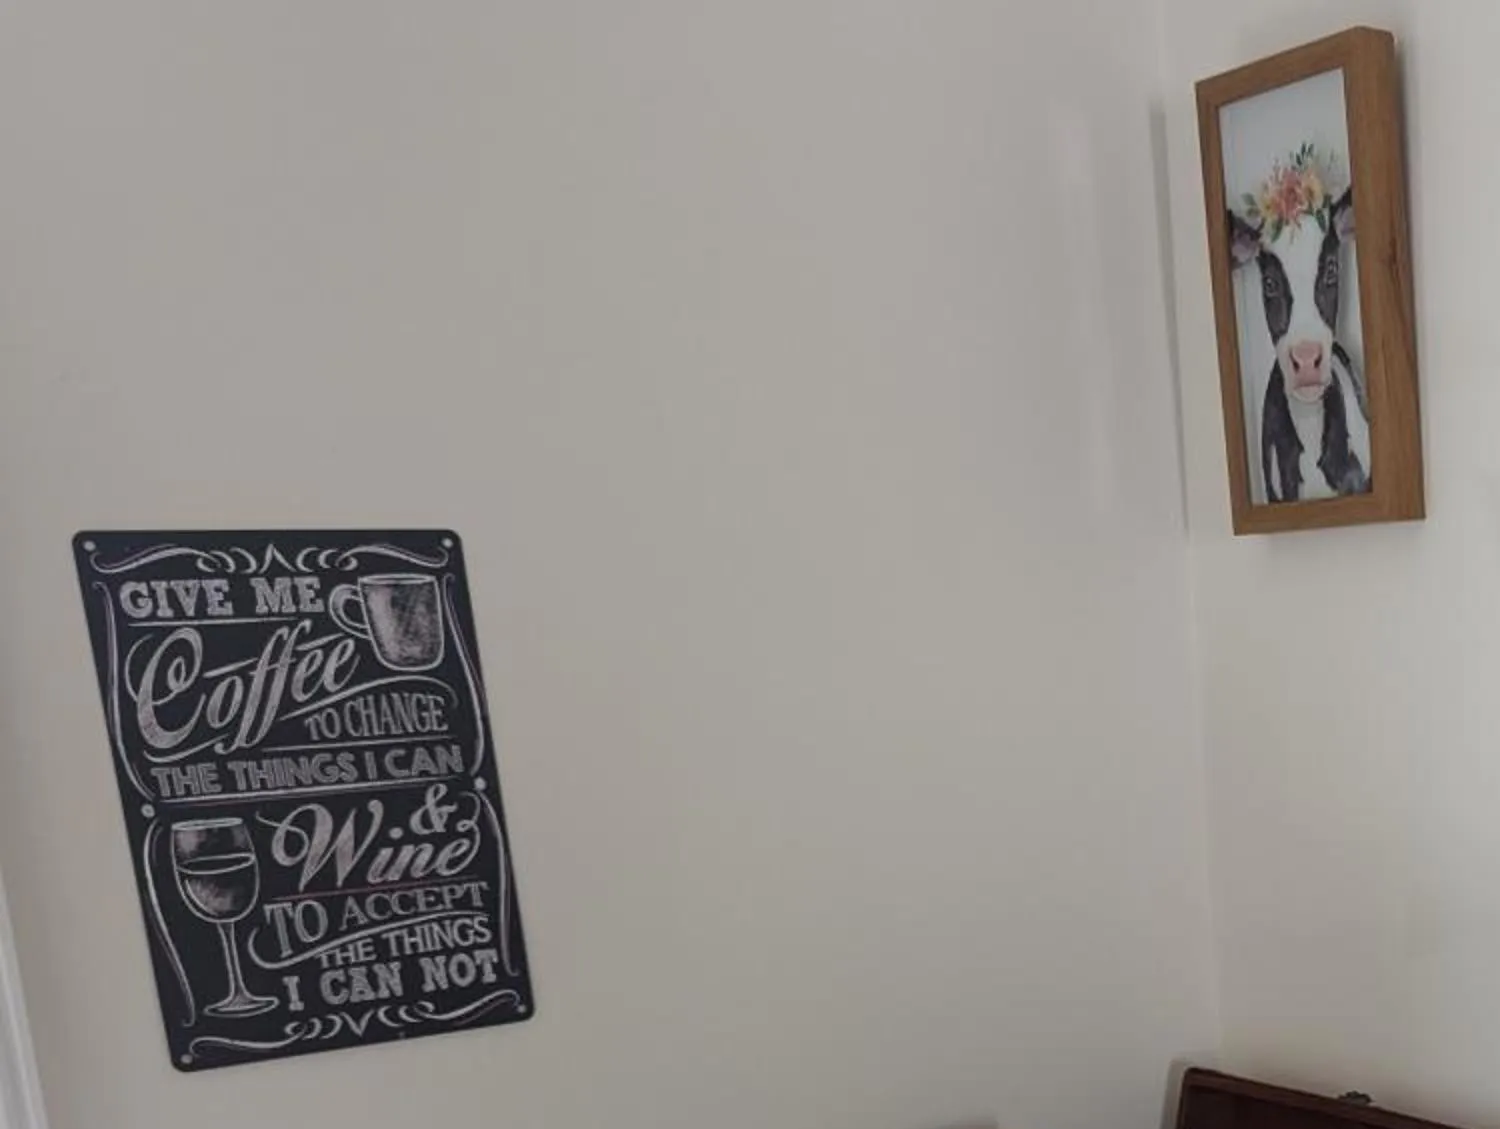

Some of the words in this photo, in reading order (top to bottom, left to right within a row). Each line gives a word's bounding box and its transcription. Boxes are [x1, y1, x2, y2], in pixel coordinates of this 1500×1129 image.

[119, 576, 234, 619] GIVE
[249, 576, 326, 615] ME
[125, 619, 361, 754] Coffee
[304, 713, 341, 741] TO
[343, 695, 450, 738] CHANGE
[150, 762, 223, 797] THE
[228, 751, 357, 790] THINGS
[364, 750, 375, 780] I
[384, 744, 465, 779] CAN
[410, 783, 457, 835] &
[256, 799, 481, 890] Wine
[264, 899, 329, 958] TO
[338, 881, 491, 932] ACCEPT
[314, 941, 377, 968] THE
[382, 916, 493, 957] THINGS
[282, 975, 305, 1011] I
[319, 963, 403, 1006] CAN
[421, 948, 499, 993] NOT
